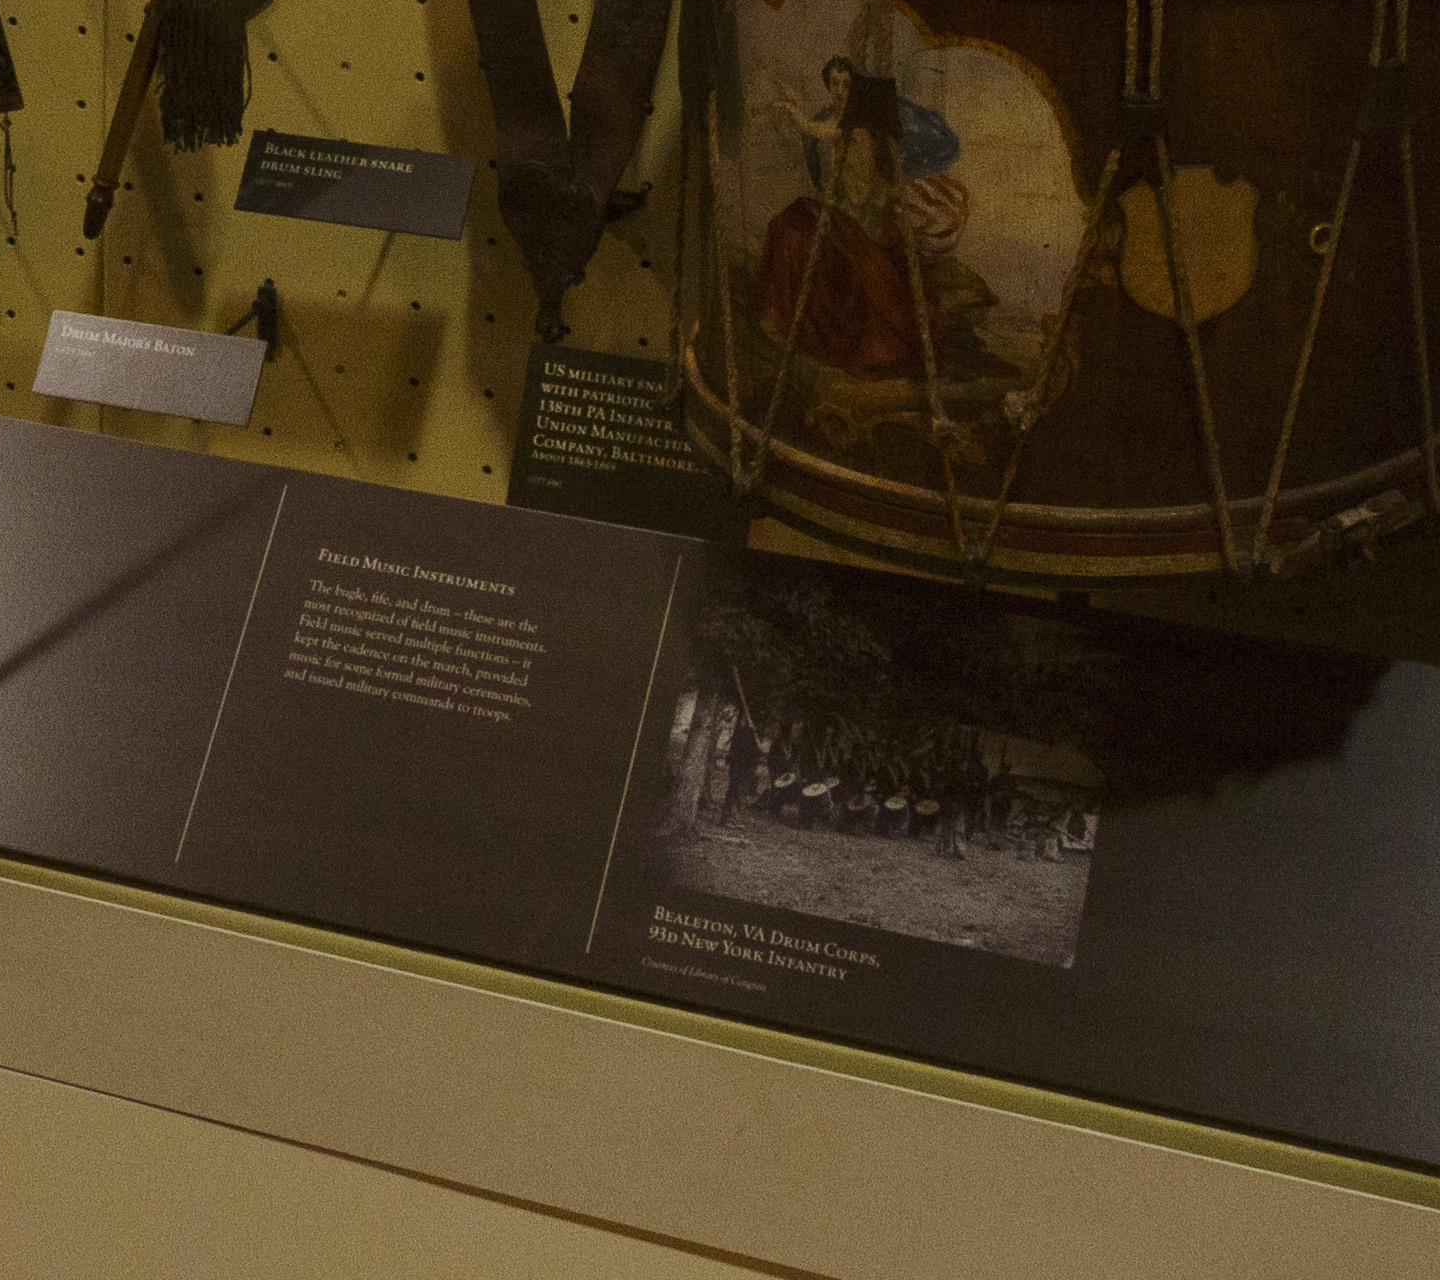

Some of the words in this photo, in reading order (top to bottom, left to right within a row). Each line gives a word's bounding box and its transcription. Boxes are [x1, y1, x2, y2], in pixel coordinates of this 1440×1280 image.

[260, 160, 301, 175] DRUM
[303, 166, 342, 180] SLING
[264, 142, 307, 159] BLACK
[308, 151, 368, 168] LEATHER
[370, 158, 414, 174] SNARE
[60, 324, 101, 342] DRUM
[102, 330, 152, 351] MAJOR'S
[154, 339, 196, 357] BATON
[541, 382, 577, 397] WITH
[581, 389, 652, 410] PATRIOTIC
[543, 362, 565, 377] US
[568, 368, 634, 388] MILITARY
[536, 415, 587, 435] UNION
[539, 398, 581, 416] 138TH
[586, 405, 606, 419] PA
[609, 409, 673, 431] INFANTR
[532, 433, 608, 458] COMPANY,
[318, 548, 360, 566] FIELD
[362, 556, 411, 576] MUSIC
[413, 565, 516, 596] INSTRUMENTS
[302, 598, 331, 612] most
[333, 602, 395, 626] recognized
[394, 613, 410, 628] of
[409, 616, 437, 632] field
[437, 624, 472, 639] music
[474, 631, 549, 654] instruments.
[307, 579, 334, 594] The
[333, 584, 370, 603] bugle,
[370, 591, 394, 606] fife,
[395, 596, 418, 610] and
[418, 600, 452, 616] drum
[462, 608, 495, 624] these
[496, 618, 516, 629] are
[517, 619, 539, 632] the
[293, 631, 320, 648] kept
[321, 636, 341, 650] the
[342, 640, 391, 659] cadence
[391, 654, 408, 663] on
[410, 653, 431, 667] the
[431, 657, 475, 677] march,
[474, 665, 530, 688] provided
[298, 614, 328, 629] Field
[329, 620, 363, 636] music
[364, 626, 403, 643] served
[403, 634, 453, 655] multiple
[454, 643, 511, 664] functions
[521, 657, 534, 669] it
[283, 666, 307, 680] and
[308, 671, 344, 687] issued
[344, 678, 390, 699] military
[391, 687, 456, 709] commands
[457, 702, 471, 712] to
[470, 706, 513, 724] troops.
[288, 650, 321, 665] music
[323, 655, 342, 668] for
[343, 662, 373, 674] some
[375, 665, 413, 682] formal
[414, 672, 461, 694] military
[462, 684, 534, 707] ceremonies,
[649, 925, 680, 944] 93D
[682, 932, 721, 952] NEW
[722, 940, 767, 962] YORK
[769, 950, 849, 979] INFANTRY
[654, 905, 741, 938] BEALETON,
[743, 924, 768, 942] VA
[771, 931, 822, 954] DRUM
[824, 941, 884, 968] CORPS,
